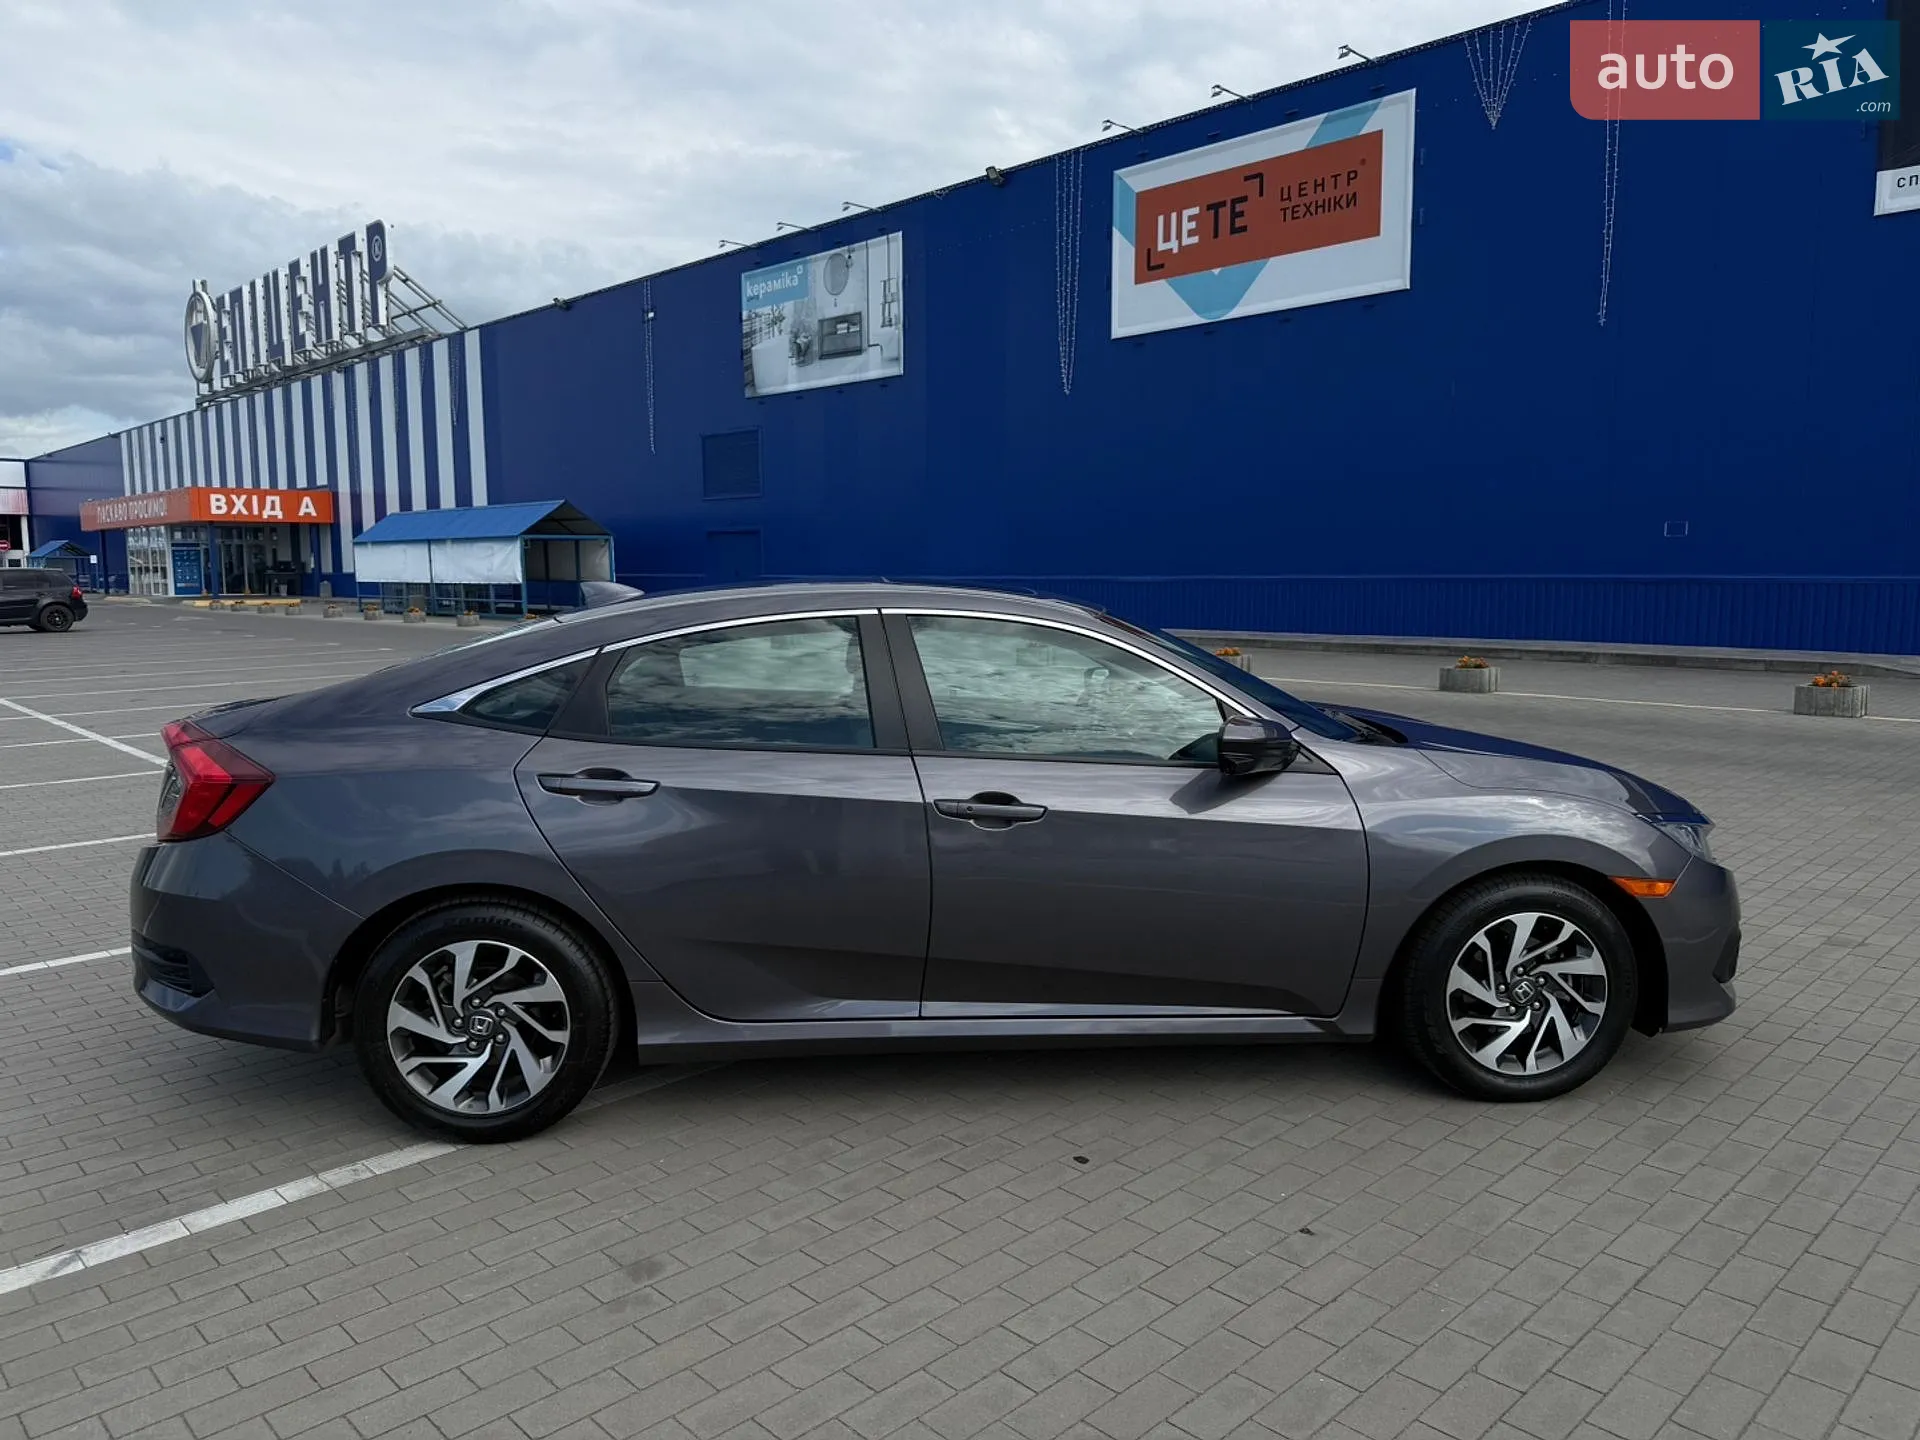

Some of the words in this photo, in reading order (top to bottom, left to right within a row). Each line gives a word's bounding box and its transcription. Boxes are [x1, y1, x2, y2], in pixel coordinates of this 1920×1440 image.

[1280, 170, 1358, 202] ЦЕНТР
[1280, 192, 1357, 222] ТЕХНІКИ
[215, 219, 393, 378] ЕПІЦЕНТР
[209, 493, 283, 519] ВХІД
[298, 496, 317, 516] А
